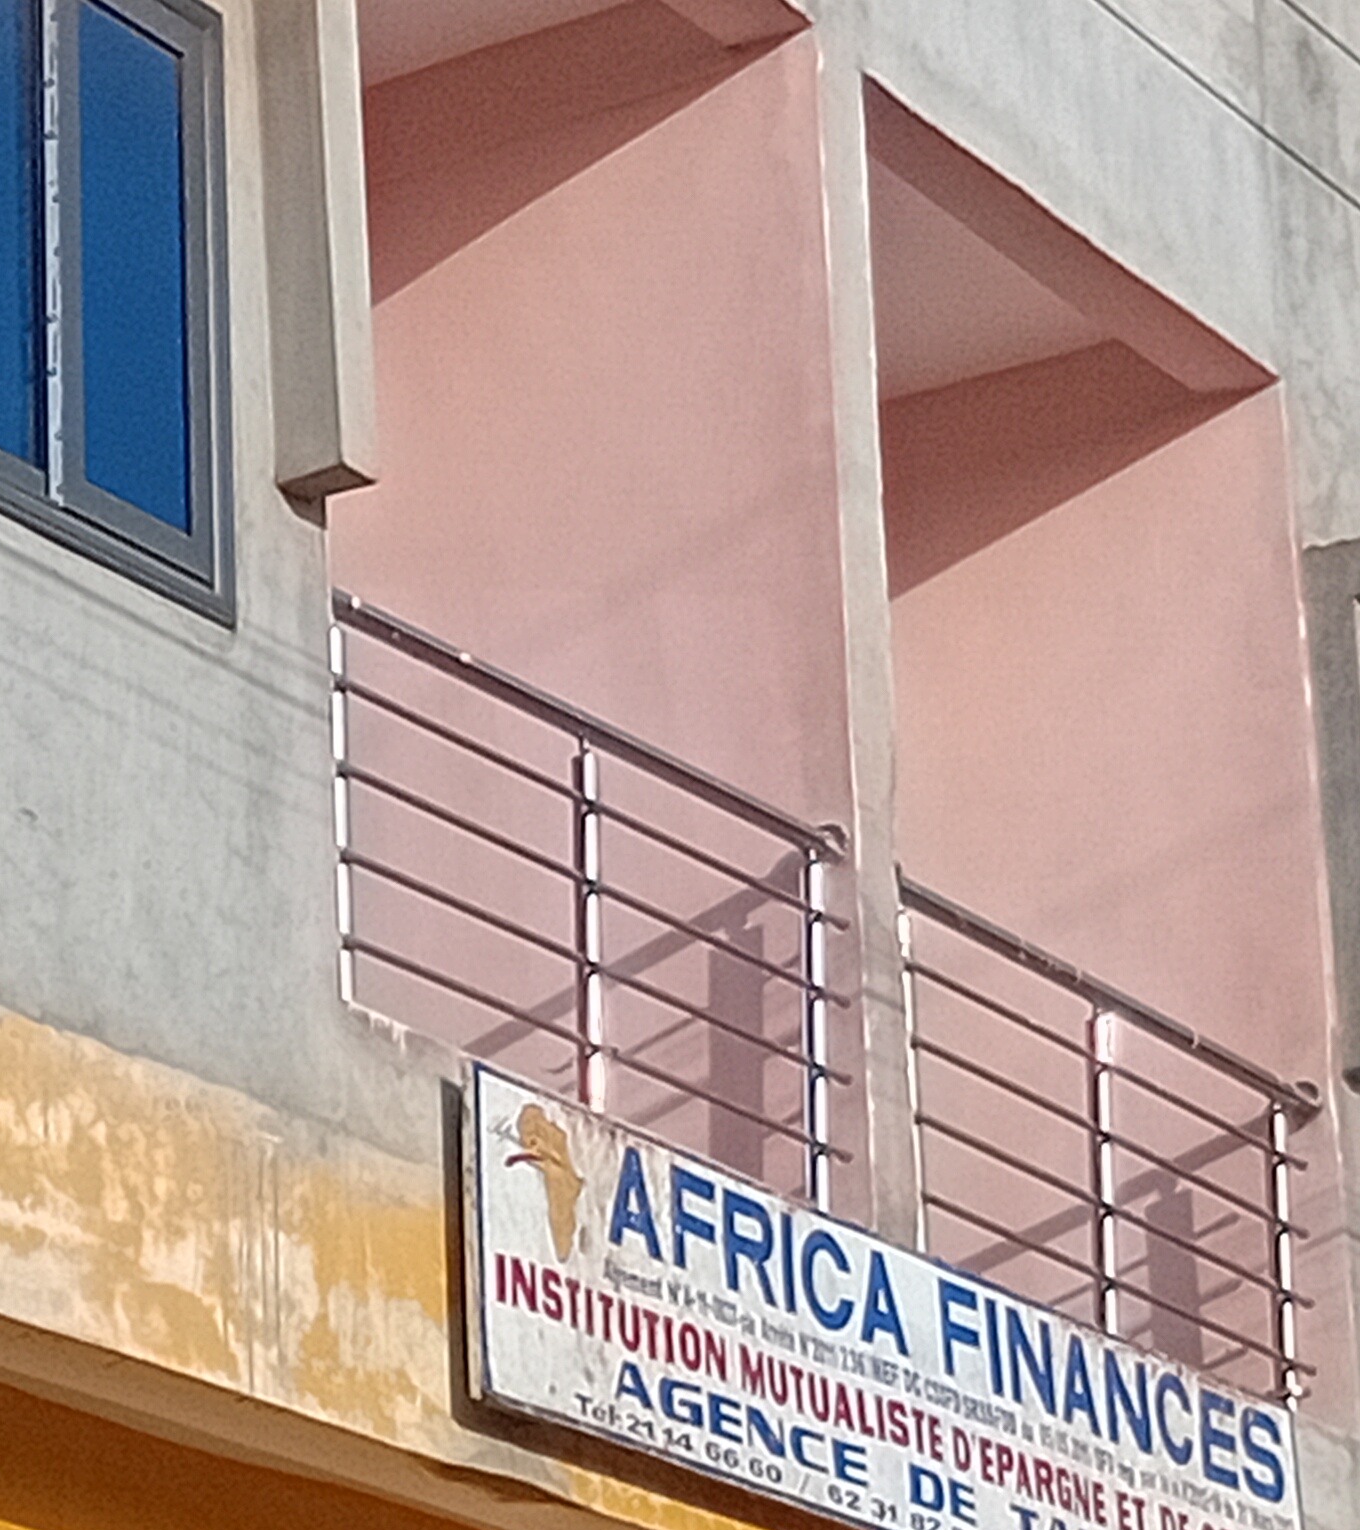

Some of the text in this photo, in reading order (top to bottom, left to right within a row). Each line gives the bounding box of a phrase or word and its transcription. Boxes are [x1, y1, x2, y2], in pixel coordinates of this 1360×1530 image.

[495, 1254, 728, 1383] INSTITUTION
[740, 1344, 943, 1463] MUTUALISTE
[953, 1426, 1108, 1529] D'EPARGNE
[609, 1147, 910, 1357] AFRICA
[938, 1278, 1285, 1504] FINANCES
[615, 1361, 869, 1488] AGENCE
[909, 1462, 978, 1527] DE
[827, 1484, 863, 1512] 62
